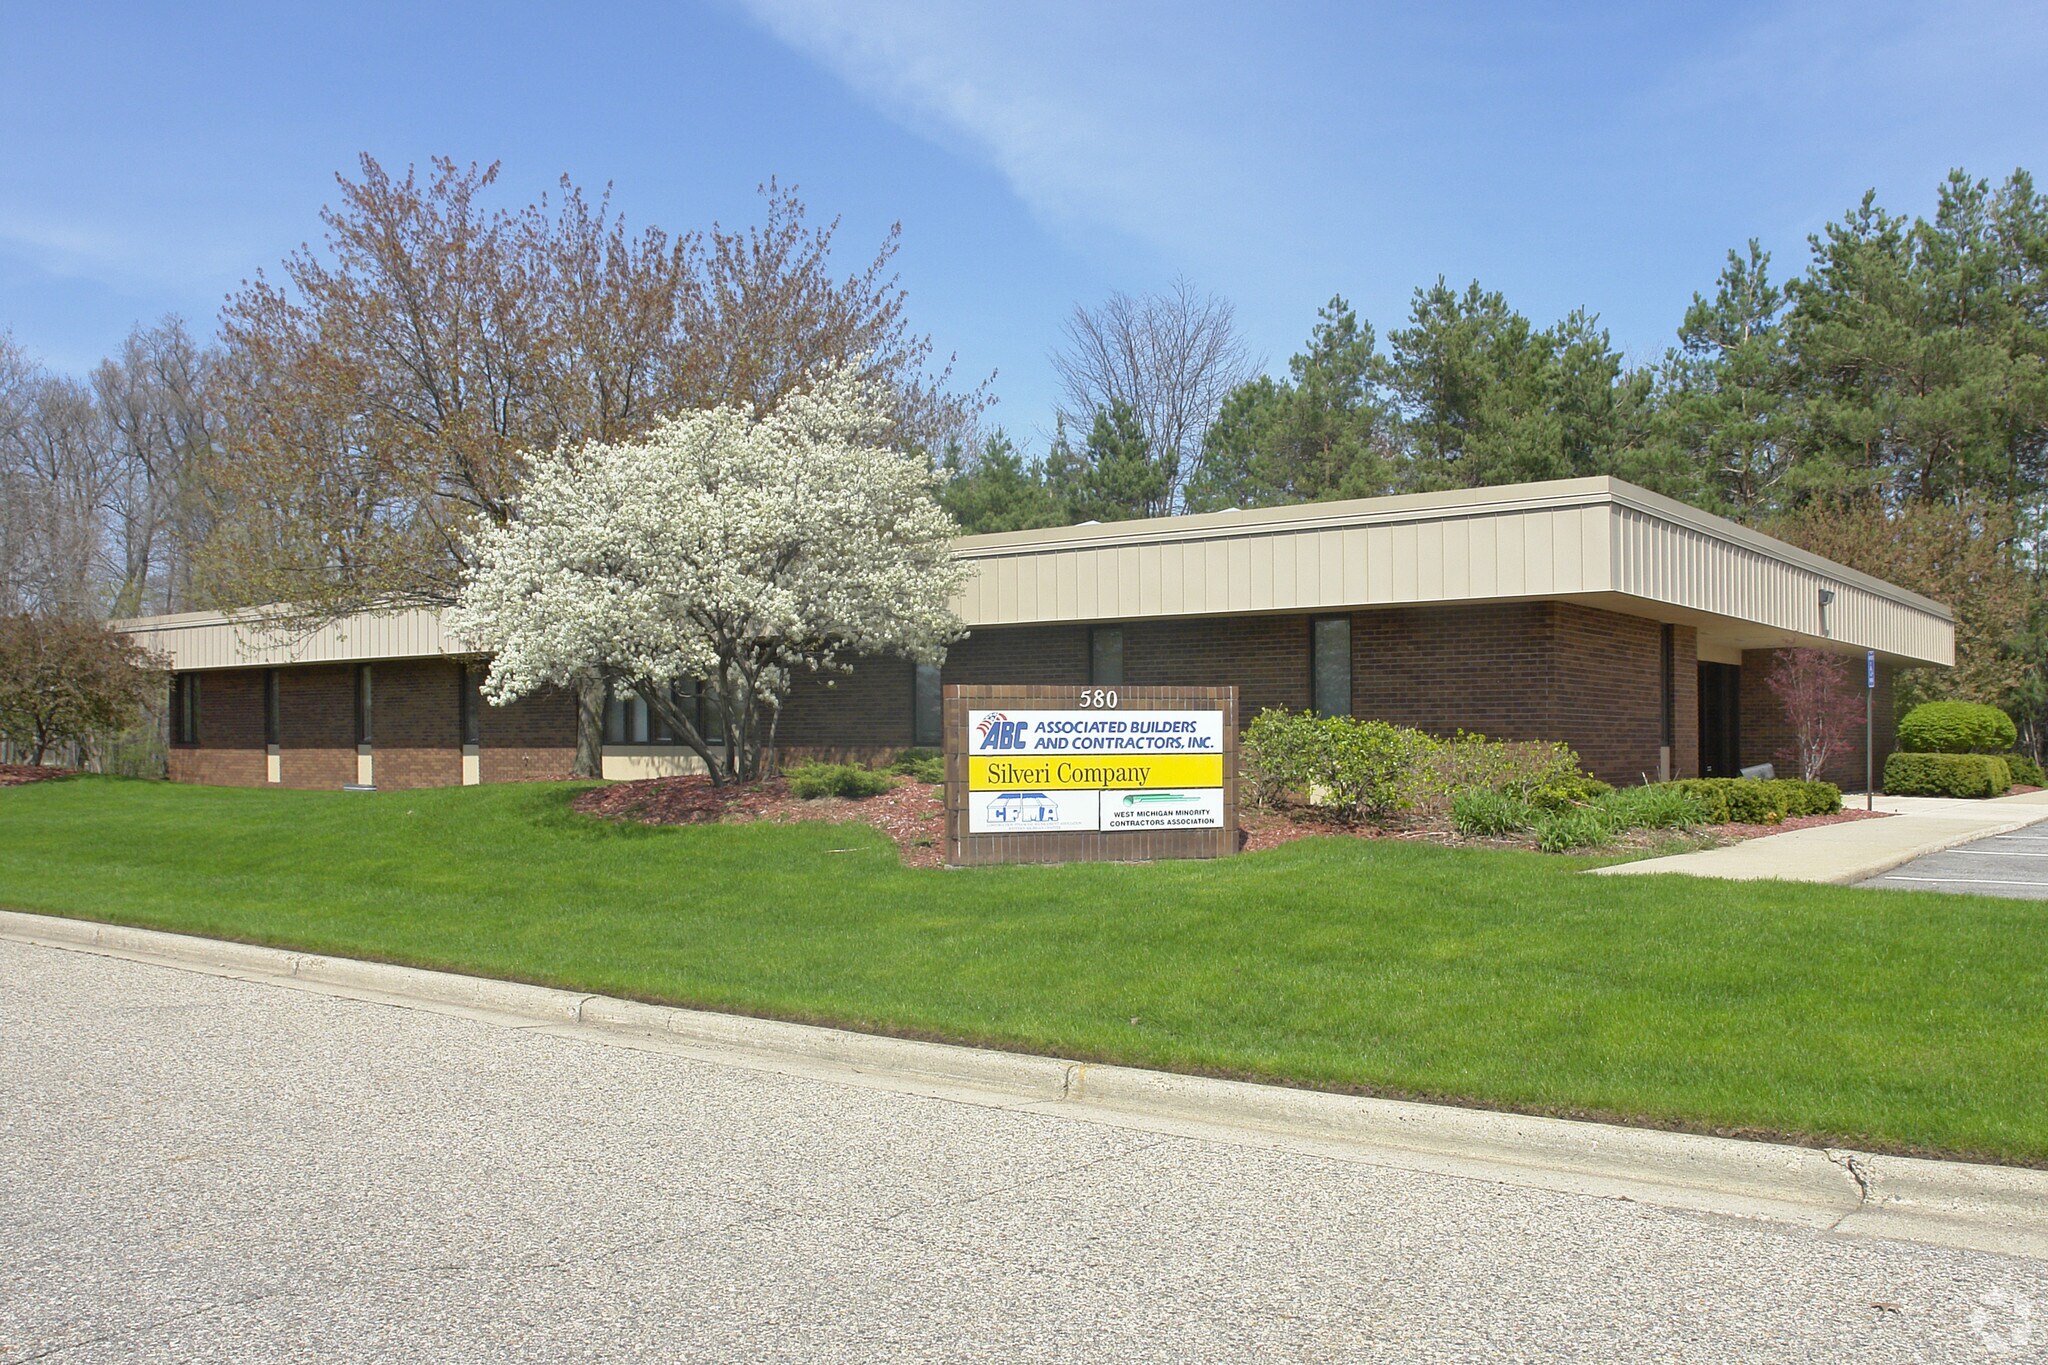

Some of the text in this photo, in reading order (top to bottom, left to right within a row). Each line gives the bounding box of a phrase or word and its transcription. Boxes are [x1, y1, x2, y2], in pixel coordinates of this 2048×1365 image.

[1079, 690, 1118, 708] 580
[1034, 721, 1197, 733] ASSOCIATED BUILDERS
[980, 721, 1028, 750] ABC
[1034, 737, 1214, 750] AND CONTRACTORS, INC.
[988, 763, 1151, 787] Silveri Company
[1109, 818, 1215, 827] CONTRACTORS ASSOCIATION
